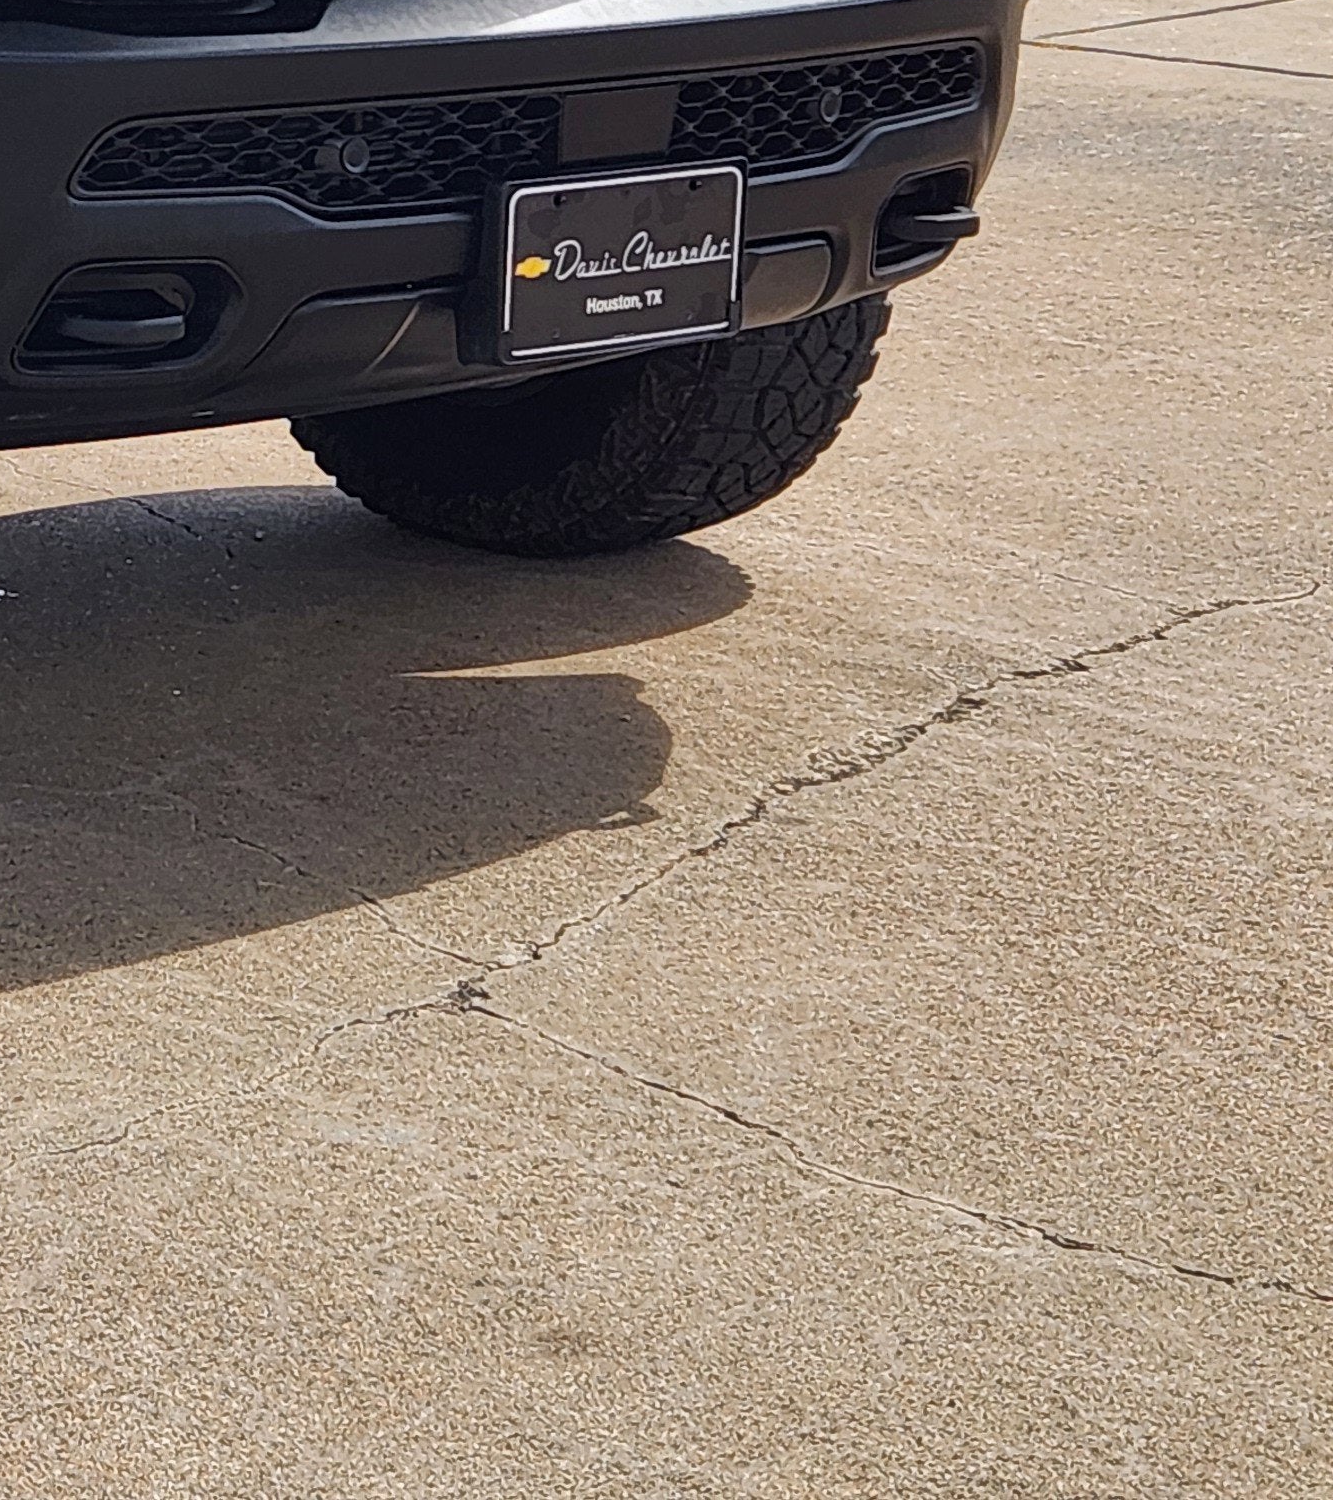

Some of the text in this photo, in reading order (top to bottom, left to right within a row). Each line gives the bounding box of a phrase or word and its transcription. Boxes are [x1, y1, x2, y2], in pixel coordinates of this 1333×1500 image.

[554, 231, 732, 280] Davis Chevrolet
[586, 288, 663, 314] Houston, TX
